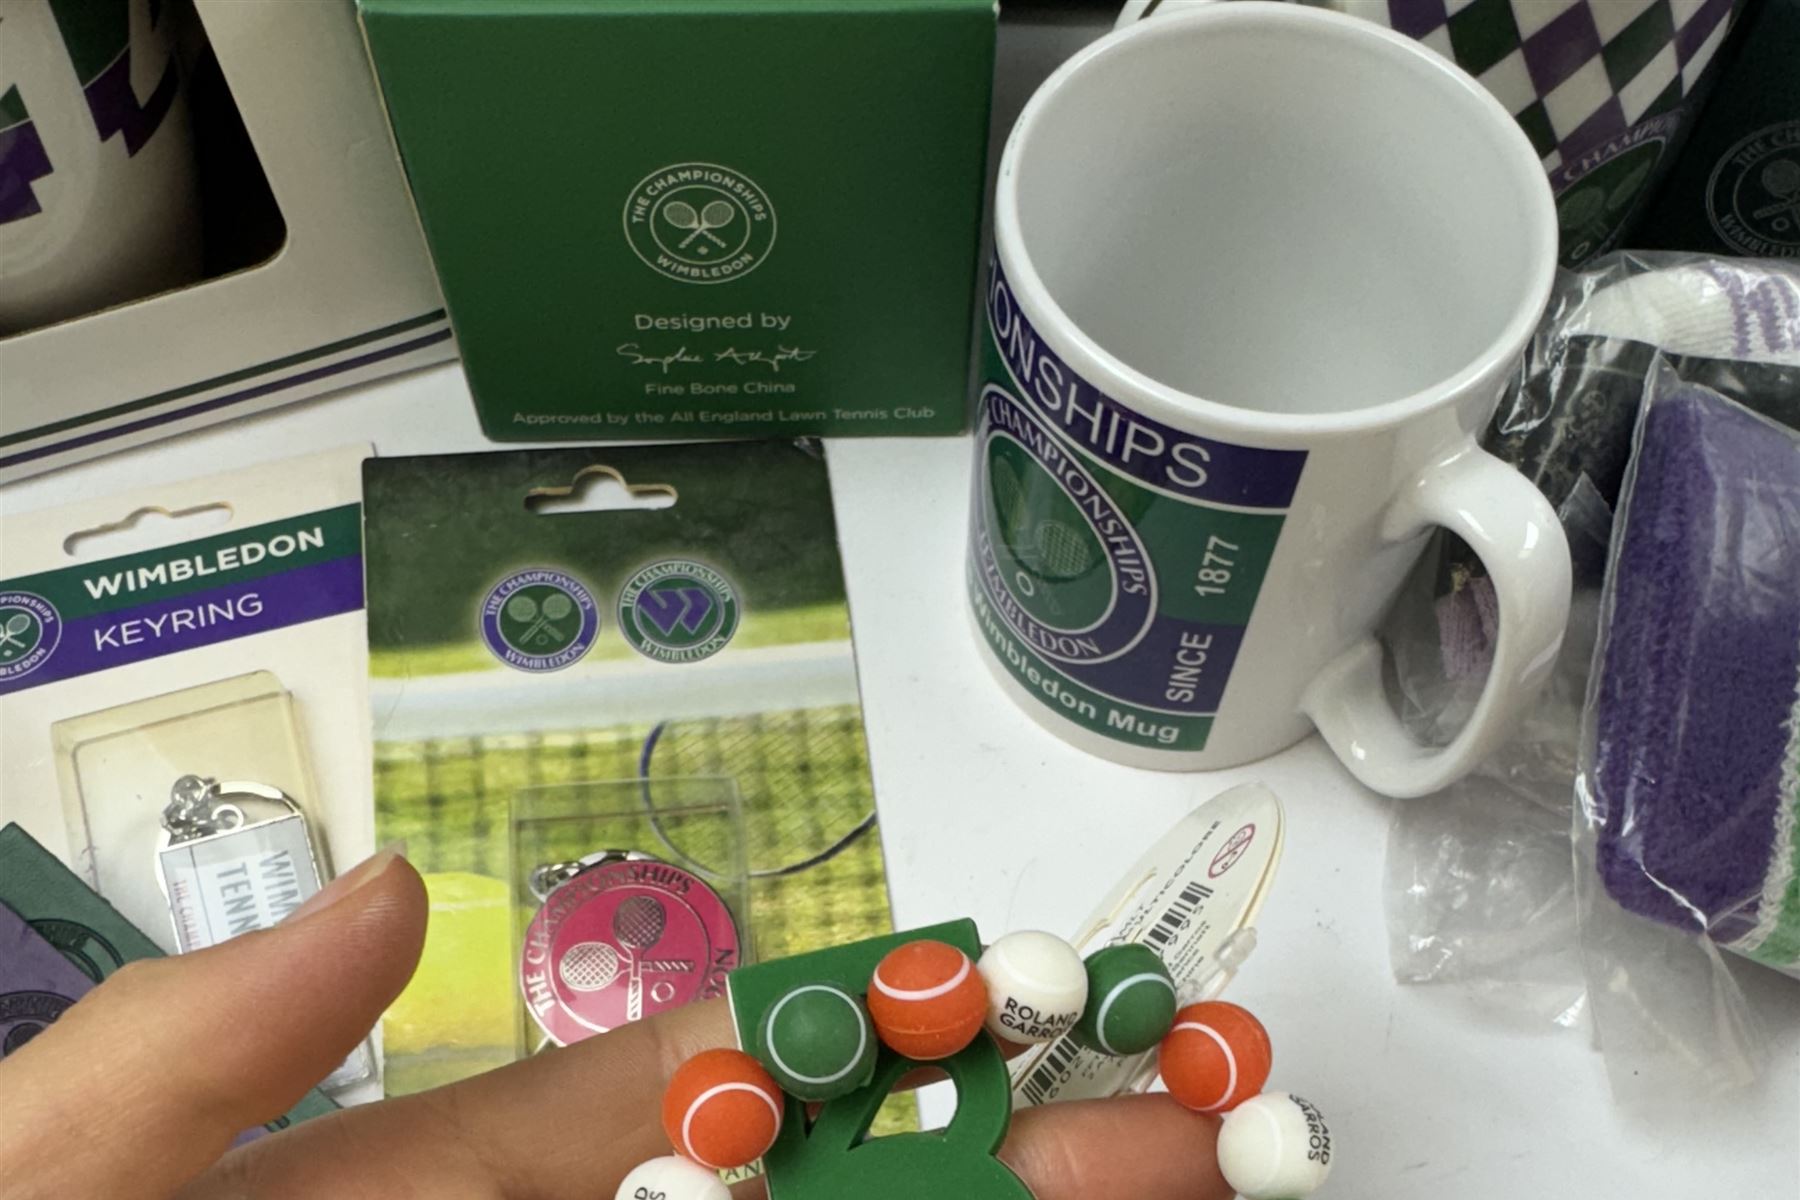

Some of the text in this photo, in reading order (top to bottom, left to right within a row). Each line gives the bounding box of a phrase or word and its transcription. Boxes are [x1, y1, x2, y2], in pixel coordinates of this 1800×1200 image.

[632, 169, 767, 224] THE CHAMPIONSHIPS
[656, 252, 754, 279] WIMBLEDON
[635, 312, 792, 332] Designed by
[645, 381, 796, 395] Fine Bone China
[512, 406, 935, 426] Approved by the All England Lawn Tennis Club
[991, 396, 1147, 597] CHAMPIONSHIPS
[83, 526, 325, 600] WIMBLEDON
[486, 571, 592, 617] THE CHAMPIONSHIPS
[622, 562, 731, 608] THE CHAMPIONSHIPS
[93, 593, 264, 652] KEYRING
[1165, 535, 1240, 704] SINCE 1877
[504, 641, 586, 670] WIMBLEDON
[640, 635, 727, 662] WIMBLEDON
[1106, 708, 1181, 744] Mug
[525, 863, 694, 1018] THE CHAMPIONSHIPS
[1004, 996, 1078, 1027] ROLAND
